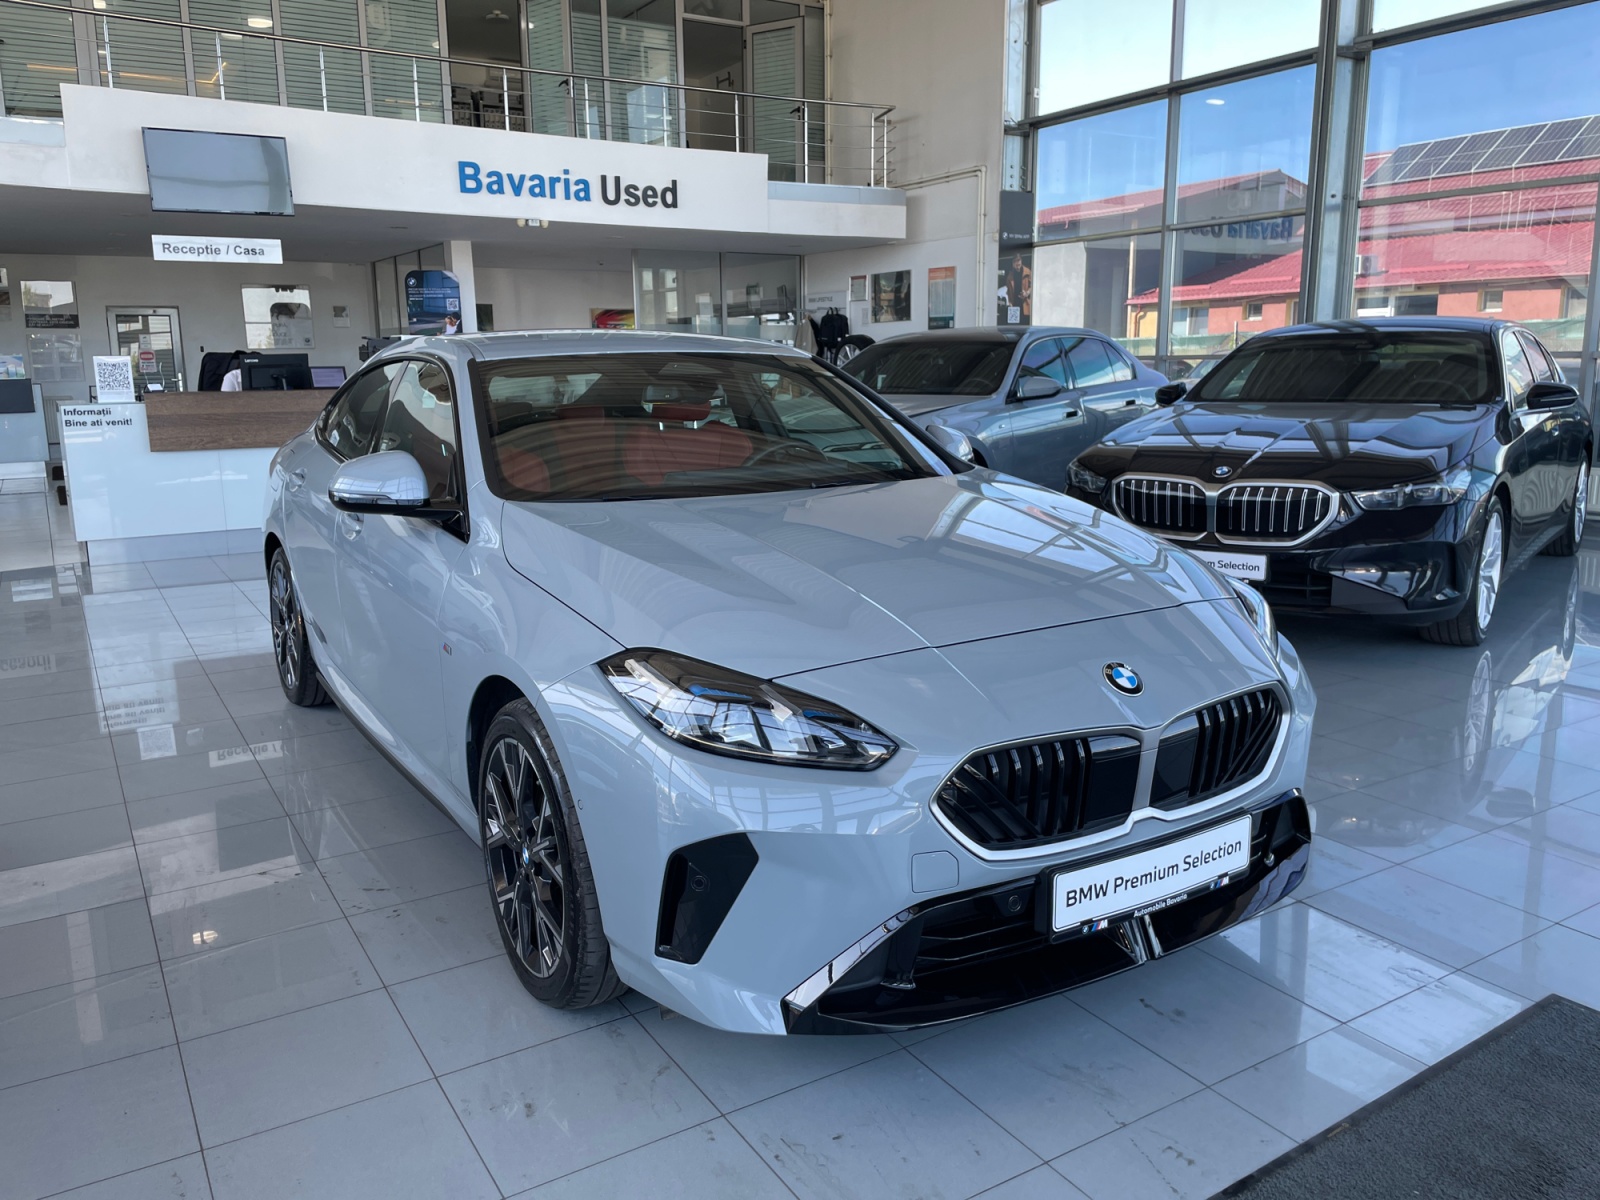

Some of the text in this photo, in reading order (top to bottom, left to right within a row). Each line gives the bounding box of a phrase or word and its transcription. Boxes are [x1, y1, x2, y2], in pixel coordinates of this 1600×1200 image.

[458, 160, 679, 209] Bavaria Used
[162, 242, 265, 257] Receptie / Casa
[64, 418, 133, 428] Bine ati venit!
[1217, 559, 1260, 572] Selection
[1065, 840, 1242, 908] BMW Premium Selection
[1133, 893, 1188, 918] Automobile Bavaria
